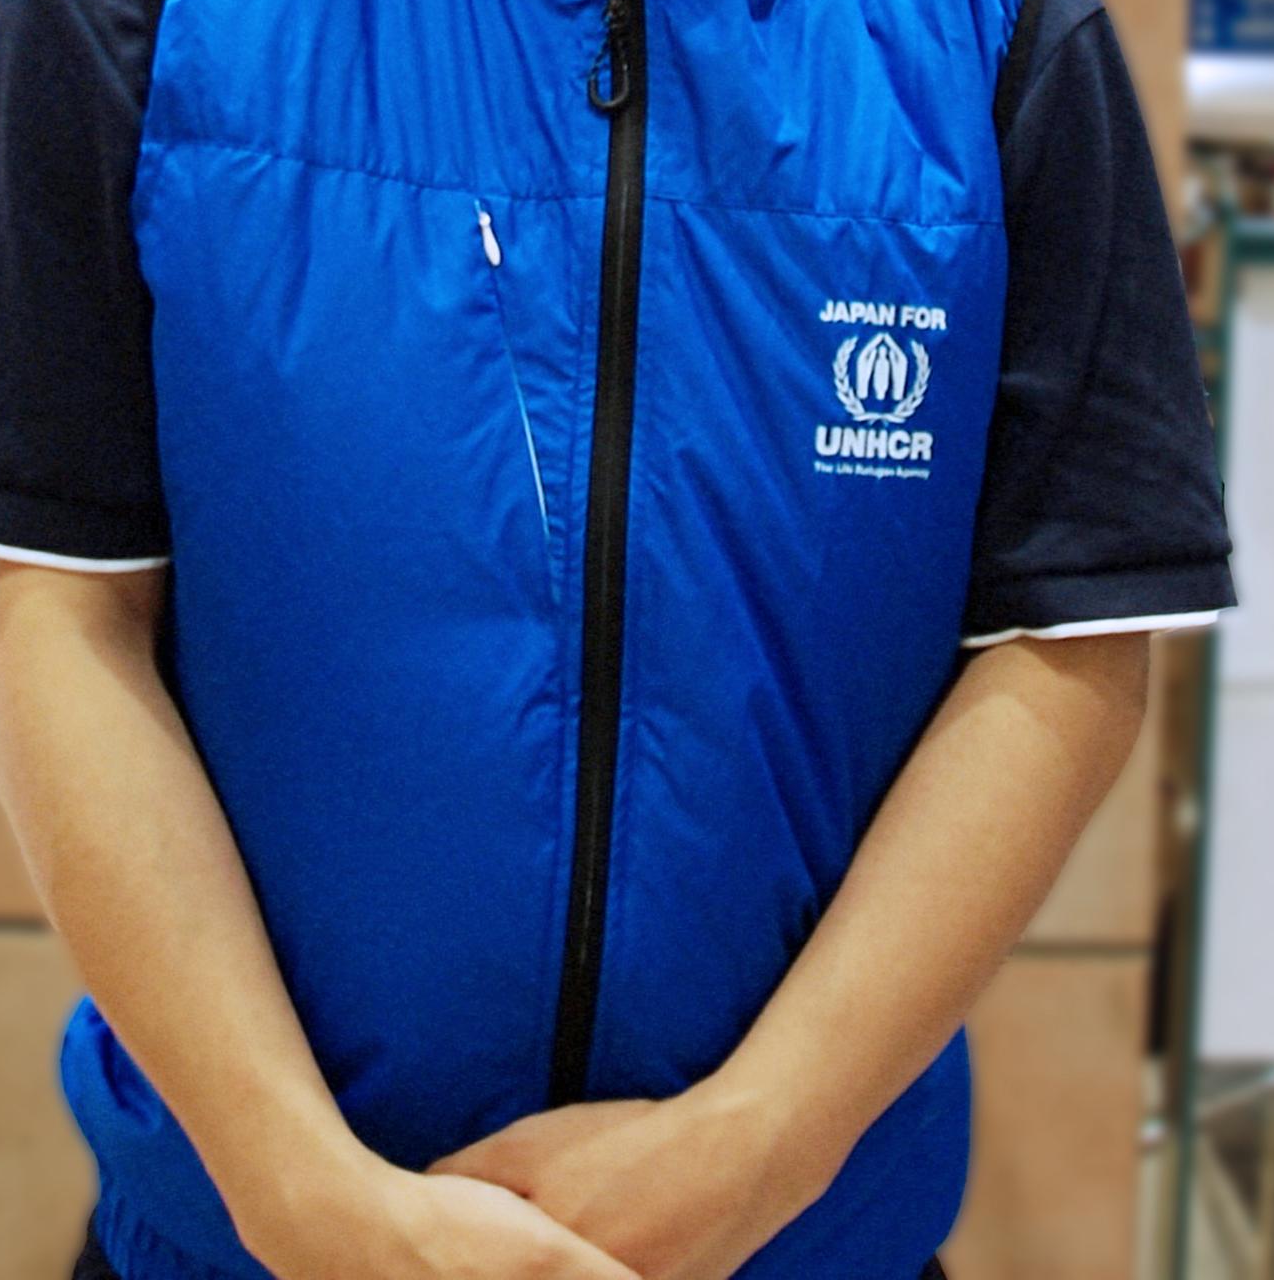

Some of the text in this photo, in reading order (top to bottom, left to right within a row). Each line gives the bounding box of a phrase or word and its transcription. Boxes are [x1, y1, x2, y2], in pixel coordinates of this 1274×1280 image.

[819, 300, 947, 330] JAPAN FOR
[815, 425, 933, 461] UNHCR
